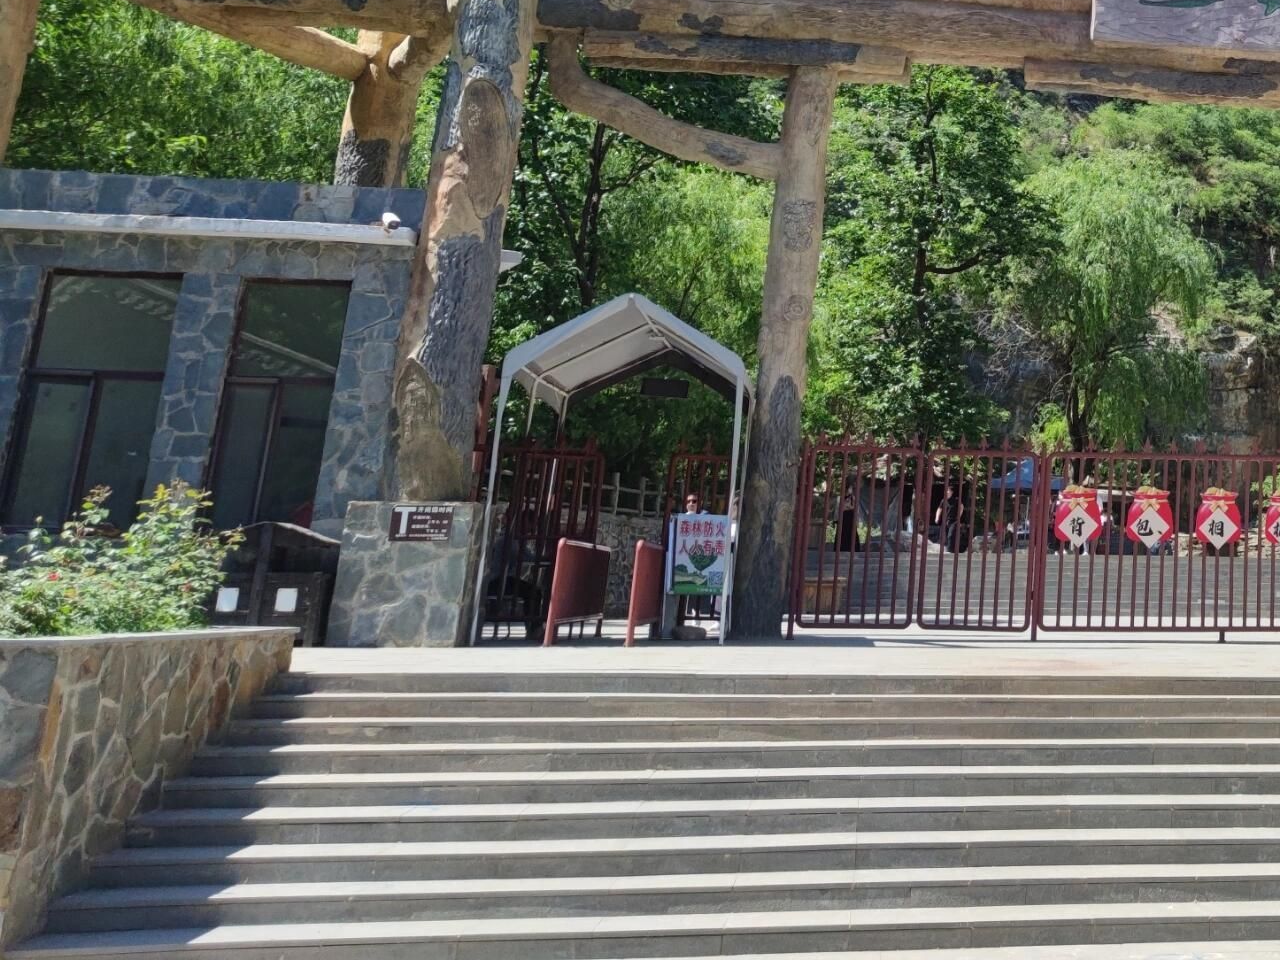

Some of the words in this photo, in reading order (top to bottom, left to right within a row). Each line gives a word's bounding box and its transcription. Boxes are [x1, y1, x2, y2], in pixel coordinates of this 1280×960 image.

[680, 520, 726, 538] 森林防火
[1069, 517, 1085, 537] 背
[1208, 519, 1225, 538] 相
[679, 540, 726, 557] 人人有责
